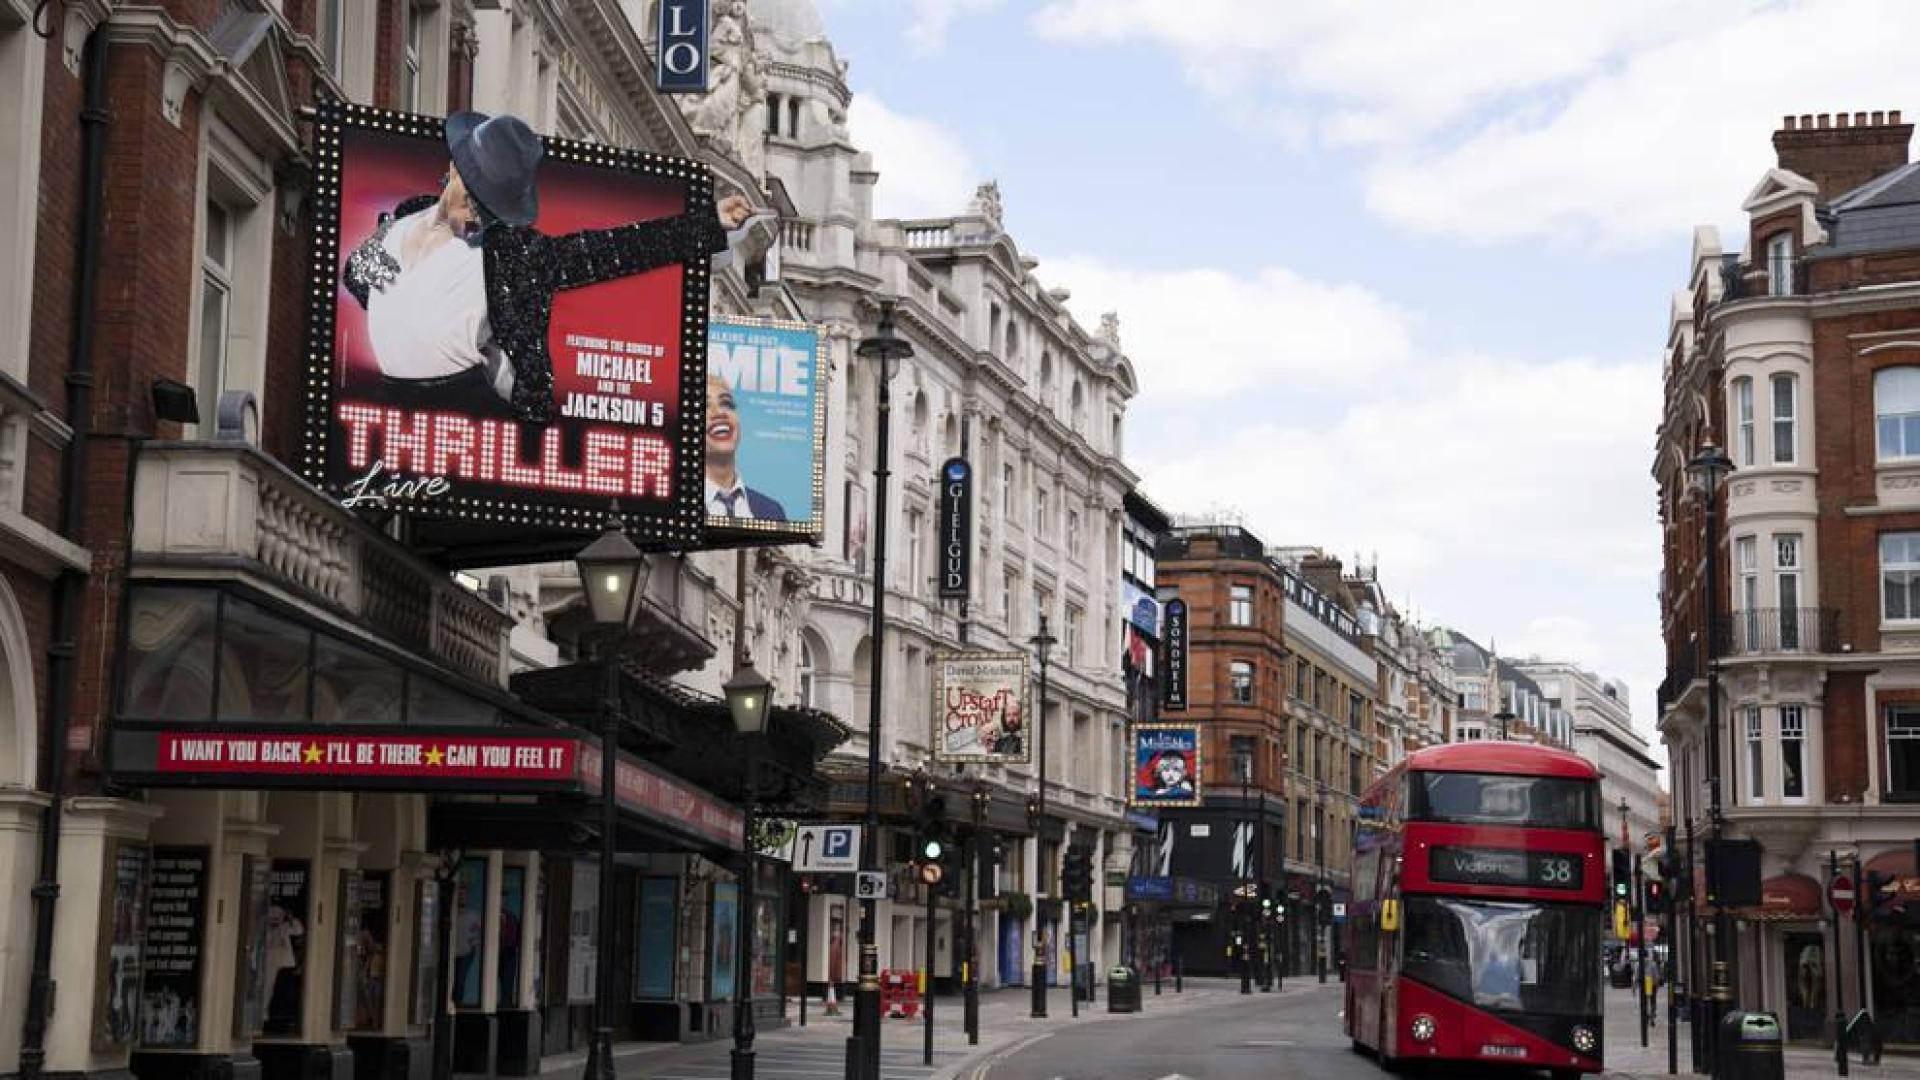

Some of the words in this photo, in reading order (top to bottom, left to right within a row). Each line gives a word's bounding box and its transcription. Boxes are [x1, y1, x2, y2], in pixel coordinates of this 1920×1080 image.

[576, 351, 652, 384] MICHAEL
[597, 380, 614, 393] AND
[616, 381, 631, 395] THE
[561, 391, 647, 425] JACKSON
[652, 402, 664, 427] 5
[339, 403, 670, 497] THRILLER
[341, 459, 450, 507] Live
[948, 482, 963, 588] GIELGUD
[170, 739, 178, 761] I
[182, 740, 223, 761] WANT
[228, 741, 257, 761] YOU
[261, 742, 302, 763] BACK
[327, 743, 352, 764] I'LL
[356, 744, 374, 765] BE
[380, 744, 422, 765] THERE
[447, 745, 477, 766] CAN
[482, 746, 511, 767] YOU
[515, 747, 544, 768] FEEL
[549, 748, 563, 769] IT
[828, 831, 847, 854] P
[1540, 858, 1572, 882] 38
